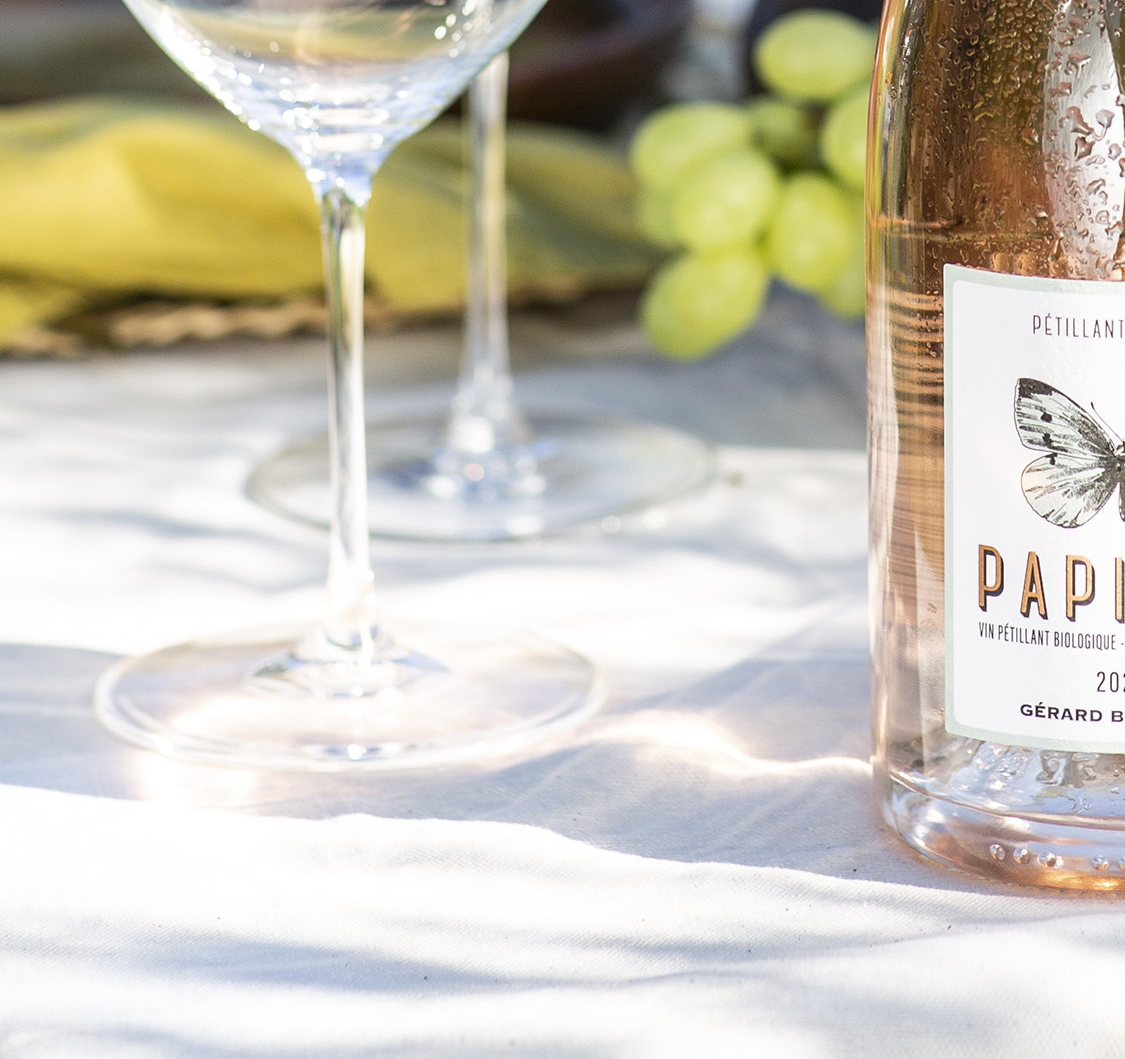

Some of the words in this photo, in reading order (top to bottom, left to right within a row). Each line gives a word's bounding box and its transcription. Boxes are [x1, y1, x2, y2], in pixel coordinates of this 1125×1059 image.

[1033, 313, 1125, 339] PÉTILLANT
[978, 621, 995, 640] VIN
[998, 625, 1050, 647] PÉTILLANT
[1053, 631, 1116, 652] BIOLOGIQUE
[1019, 701, 1103, 723] GÉRARD
